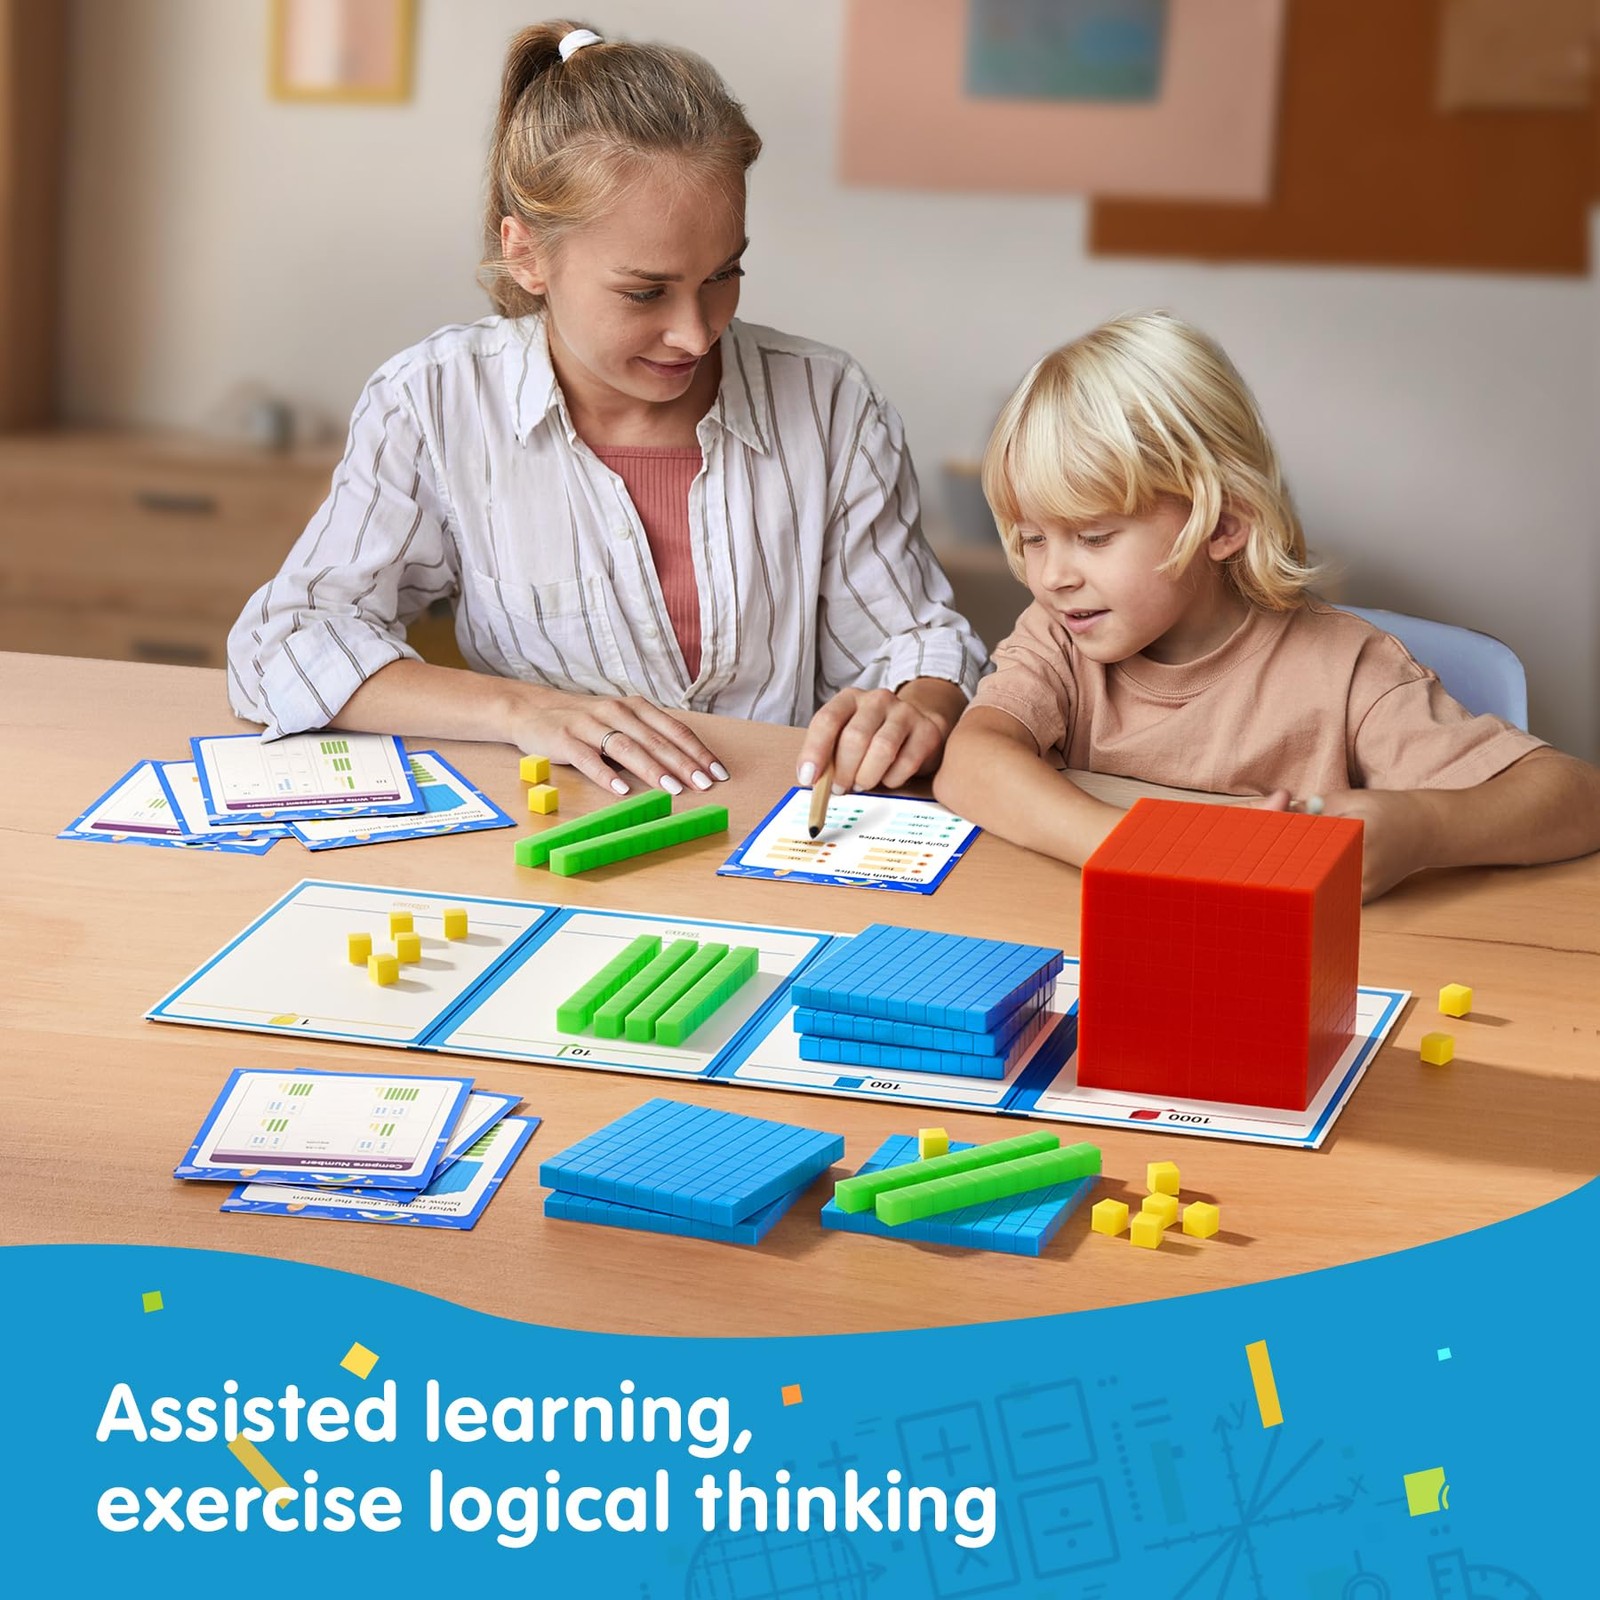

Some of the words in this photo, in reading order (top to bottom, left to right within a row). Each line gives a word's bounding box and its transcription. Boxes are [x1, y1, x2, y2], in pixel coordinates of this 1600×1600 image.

[858, 834, 896, 843] Practice
[834, 868, 871, 878] Practice
[872, 872, 898, 880] Math
[899, 875, 924, 883] Daily
[571, 1047, 592, 1056] 10
[870, 1080, 901, 1091] 100
[1167, 1112, 1212, 1125] 1000
[299, 1159, 350, 1167] Numbers
[352, 1161, 403, 1170] Compare
[291, 1194, 333, 1203] pattern
[428, 1199, 462, 1207] below
[384, 1202, 426, 1210] number
[428, 1205, 457, 1213] What
